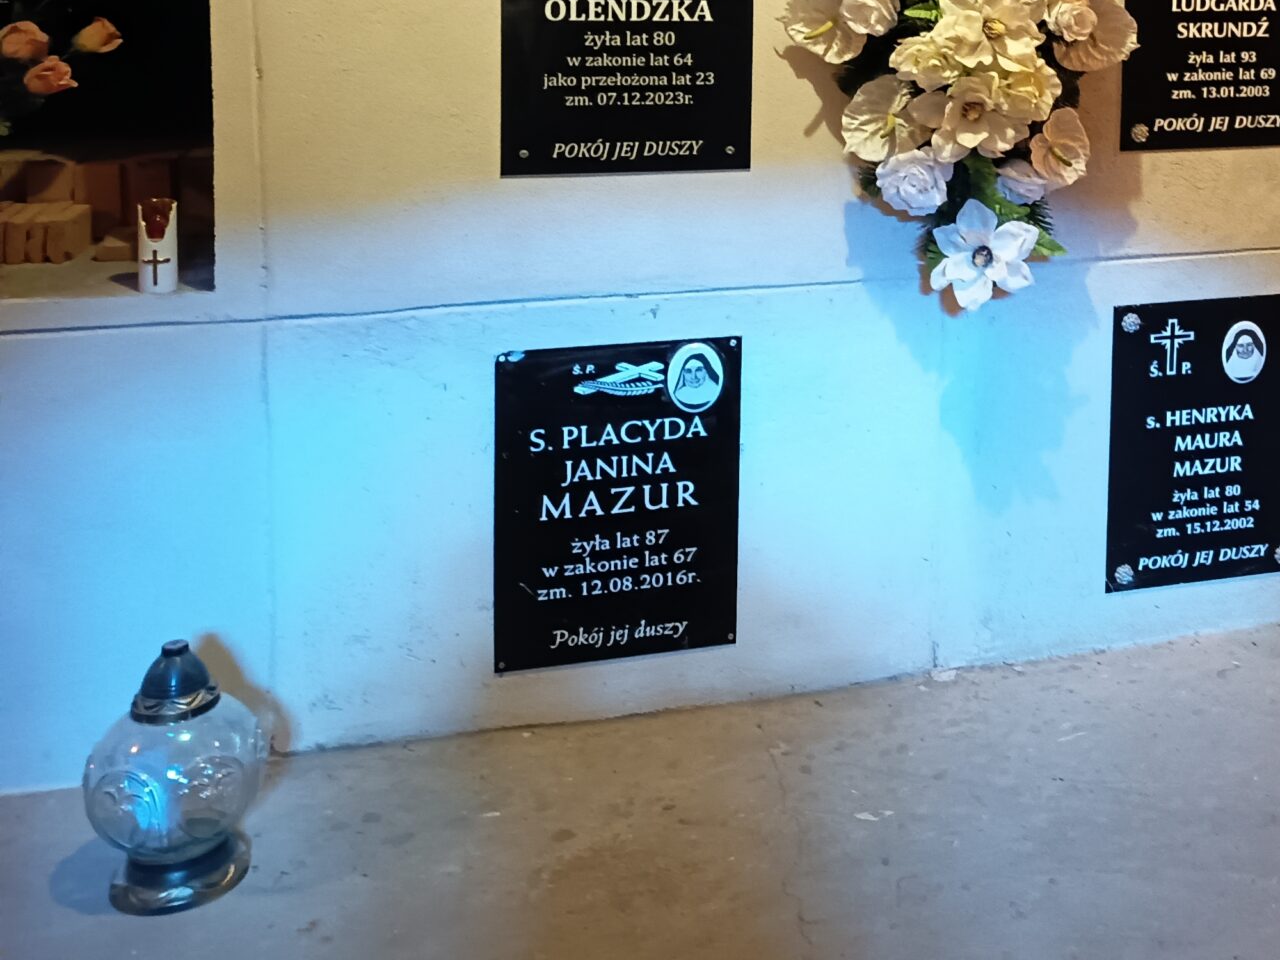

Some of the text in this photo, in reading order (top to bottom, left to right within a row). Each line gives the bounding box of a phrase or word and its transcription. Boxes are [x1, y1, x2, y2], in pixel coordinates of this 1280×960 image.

[545, 0, 713, 21] OLENDZKA
[1177, 17, 1269, 38] SKRUNDŹ
[584, 31, 675, 48] żyła lat 80
[567, 53, 692, 66] w zakonie lat 64
[1188, 51, 1256, 67] żyła lat 93
[544, 72, 714, 89] jako przełożona lat 23
[1167, 68, 1276, 81] w zakonie lat 69
[566, 92, 693, 105] zm. 07.12.2023r.
[1172, 85, 1270, 99] zm. 13.01.2003
[1154, 113, 1204, 132] POKÓJ
[1208, 116, 1229, 132] JEJ
[553, 139, 703, 160] POKÓJ JEJ DUSZY
[1182, 362, 1192, 374] P.
[1146, 404, 1254, 429] s. HENRYKA
[530, 416, 708, 452] S. PLACYDA
[1174, 430, 1243, 452] MAURA
[561, 452, 676, 487] JANINA
[1173, 456, 1242, 477] MAZUR
[540, 480, 698, 521] MAZUR
[1172, 484, 1241, 504] żyła lat 80
[1151, 499, 1260, 521] w zakonie lat 54
[1156, 516, 1254, 538] zm. 15.12.2002
[571, 529, 669, 556] żyła lat 87
[542, 547, 697, 578] w zakonie lat 67
[1138, 544, 1269, 571] POKÓJ JEJ DUSZY
[537, 570, 702, 600] zm. 12.08.2016r.
[551, 620, 688, 648] Pokój jej duszy
